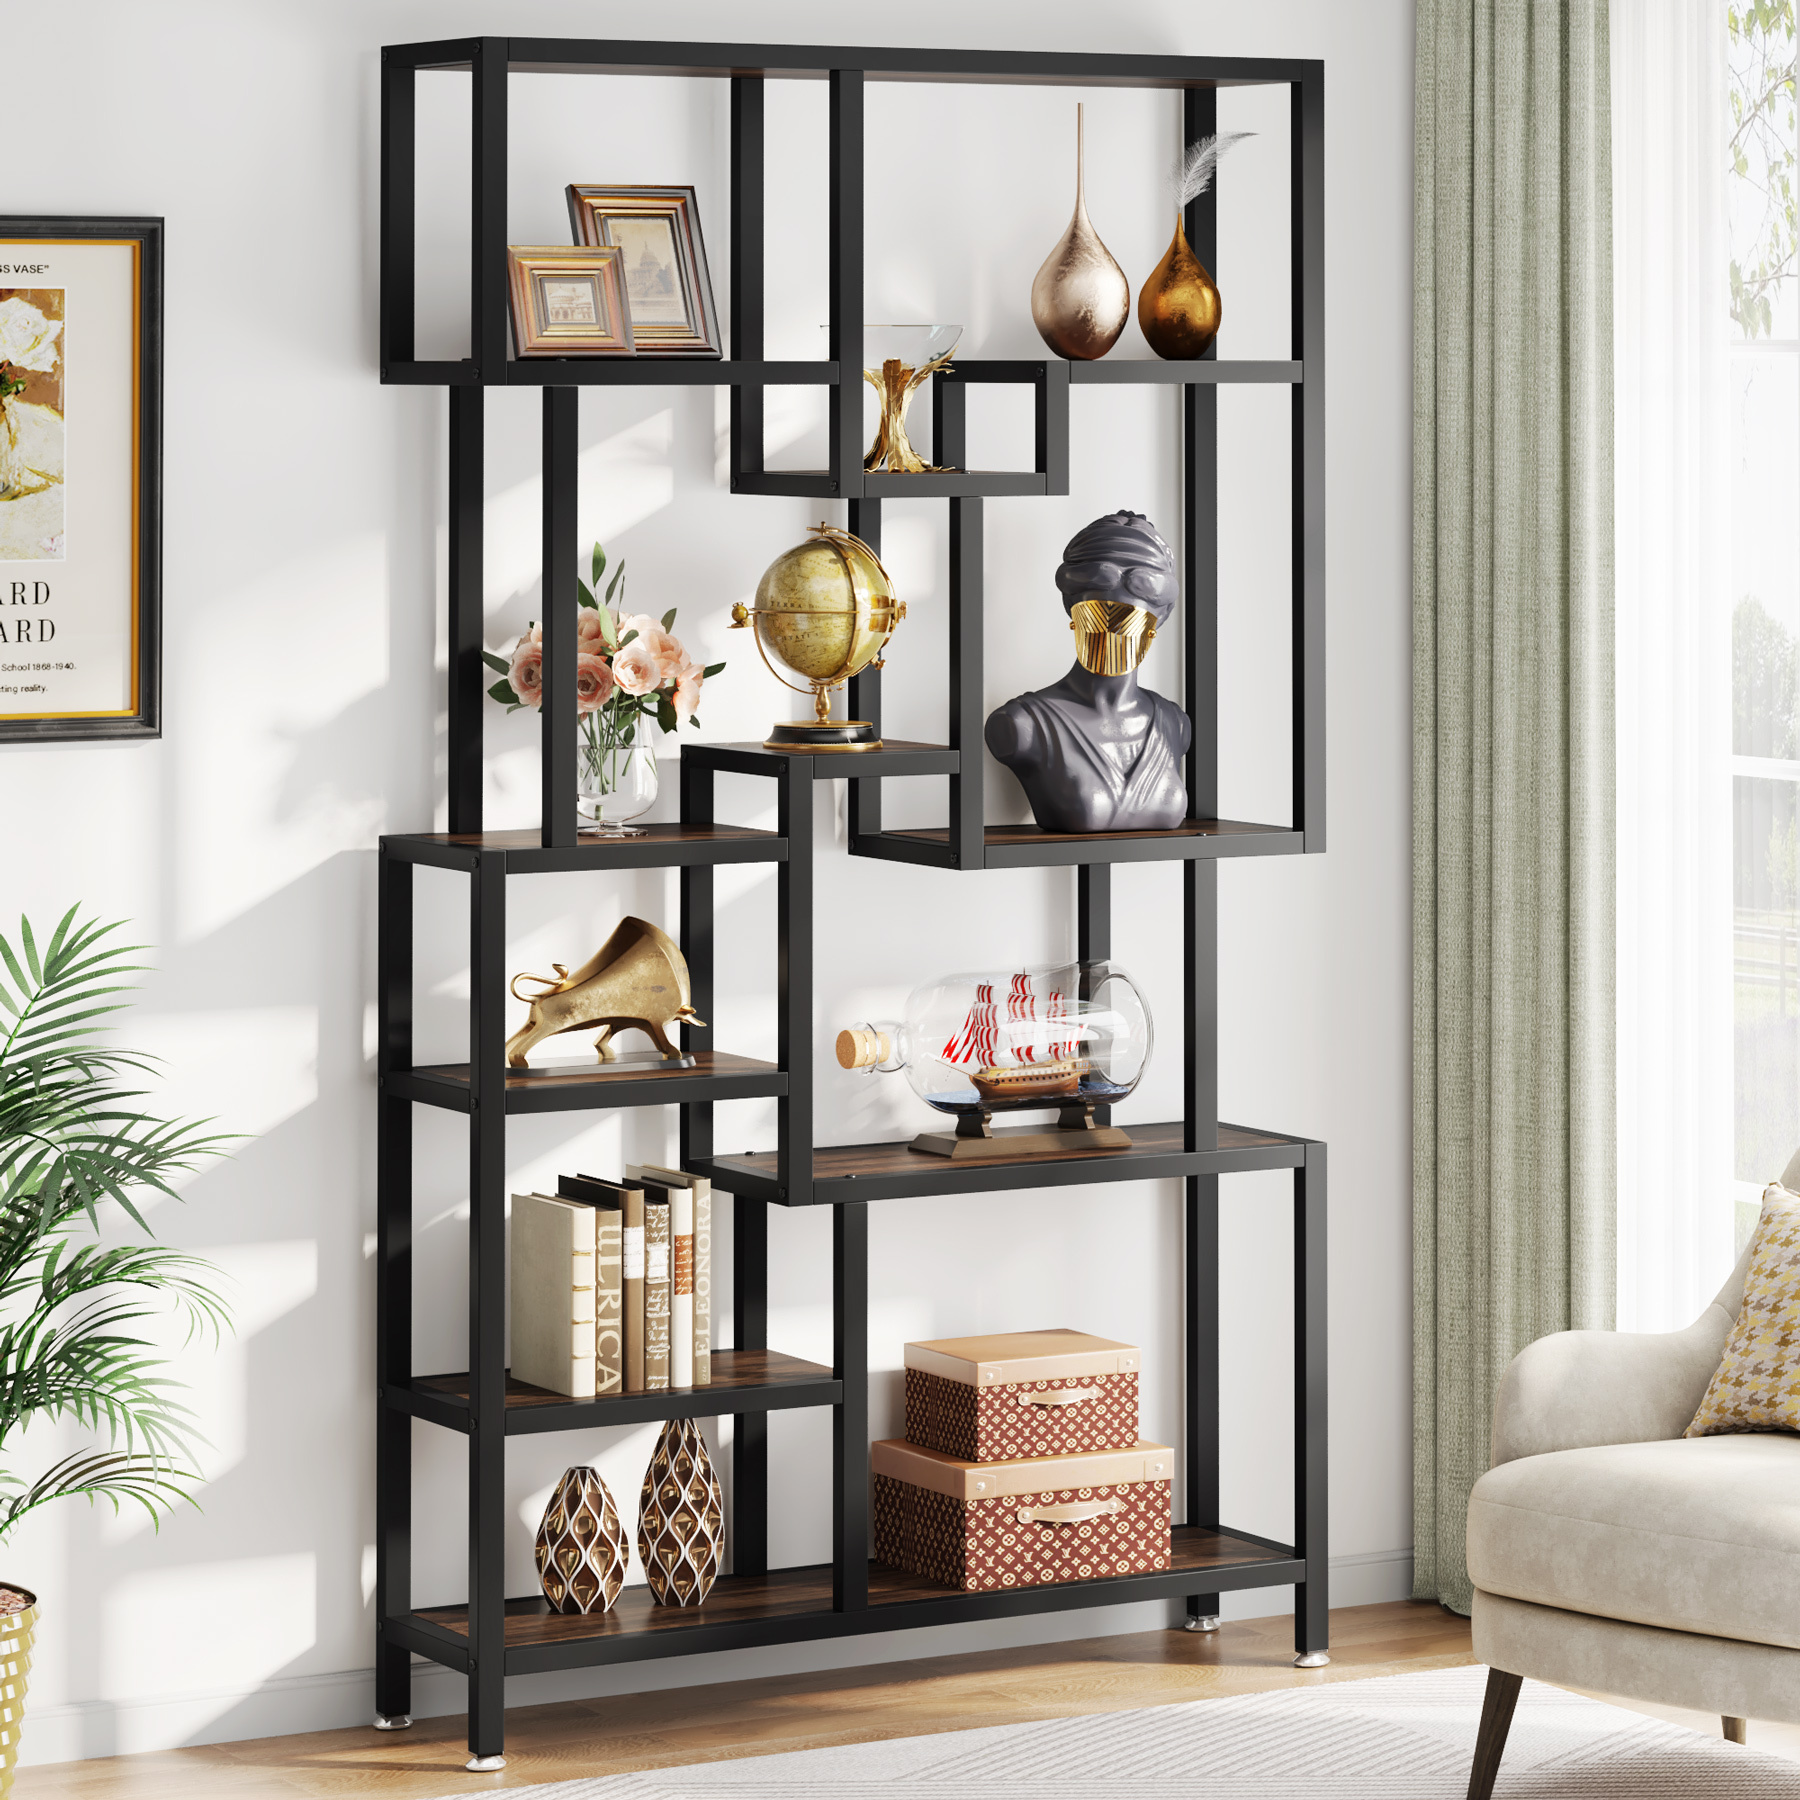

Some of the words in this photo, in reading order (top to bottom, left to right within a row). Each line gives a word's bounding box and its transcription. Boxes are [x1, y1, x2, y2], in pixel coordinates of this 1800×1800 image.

[0, 581, 51, 606] RD
[1, 662, 31, 672] School
[0, 684, 18, 695] ting
[695, 1193, 711, 1359] ELEONORA
